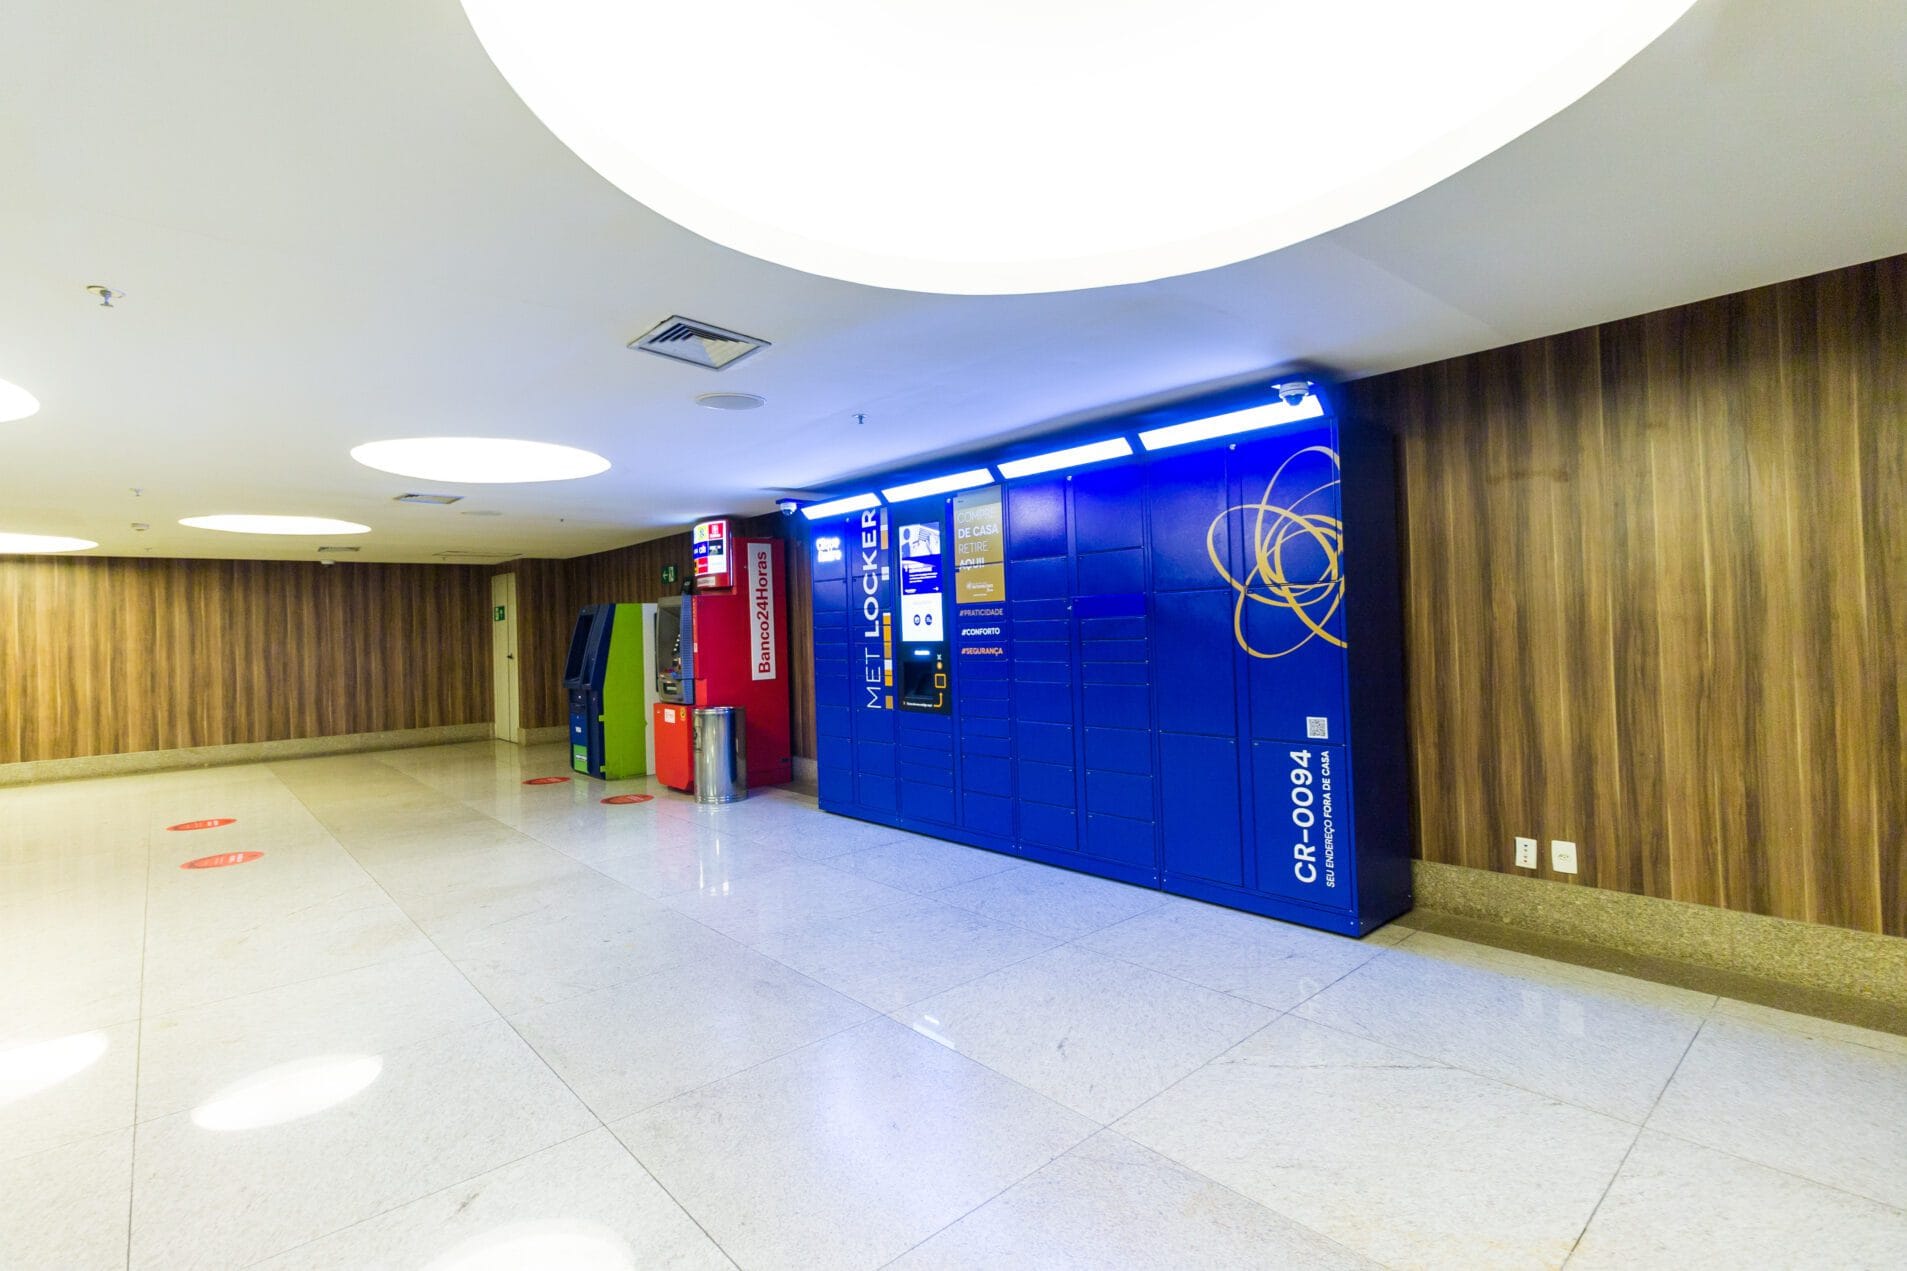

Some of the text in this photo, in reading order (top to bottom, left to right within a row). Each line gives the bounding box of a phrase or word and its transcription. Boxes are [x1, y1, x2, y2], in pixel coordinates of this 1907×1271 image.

[958, 524, 999, 539] DE CASA
[959, 541, 990, 554] RETIRE
[755, 551, 771, 673] Banco24Horas
[861, 508, 882, 708] MET LOCKER
[959, 608, 1004, 616] #PRATICIDADE
[961, 627, 1001, 636] #CONFORTO
[961, 647, 1004, 656] #SEGURANÇA
[1321, 751, 1336, 888] SEU ENDEREÇO FORA DE CASA
